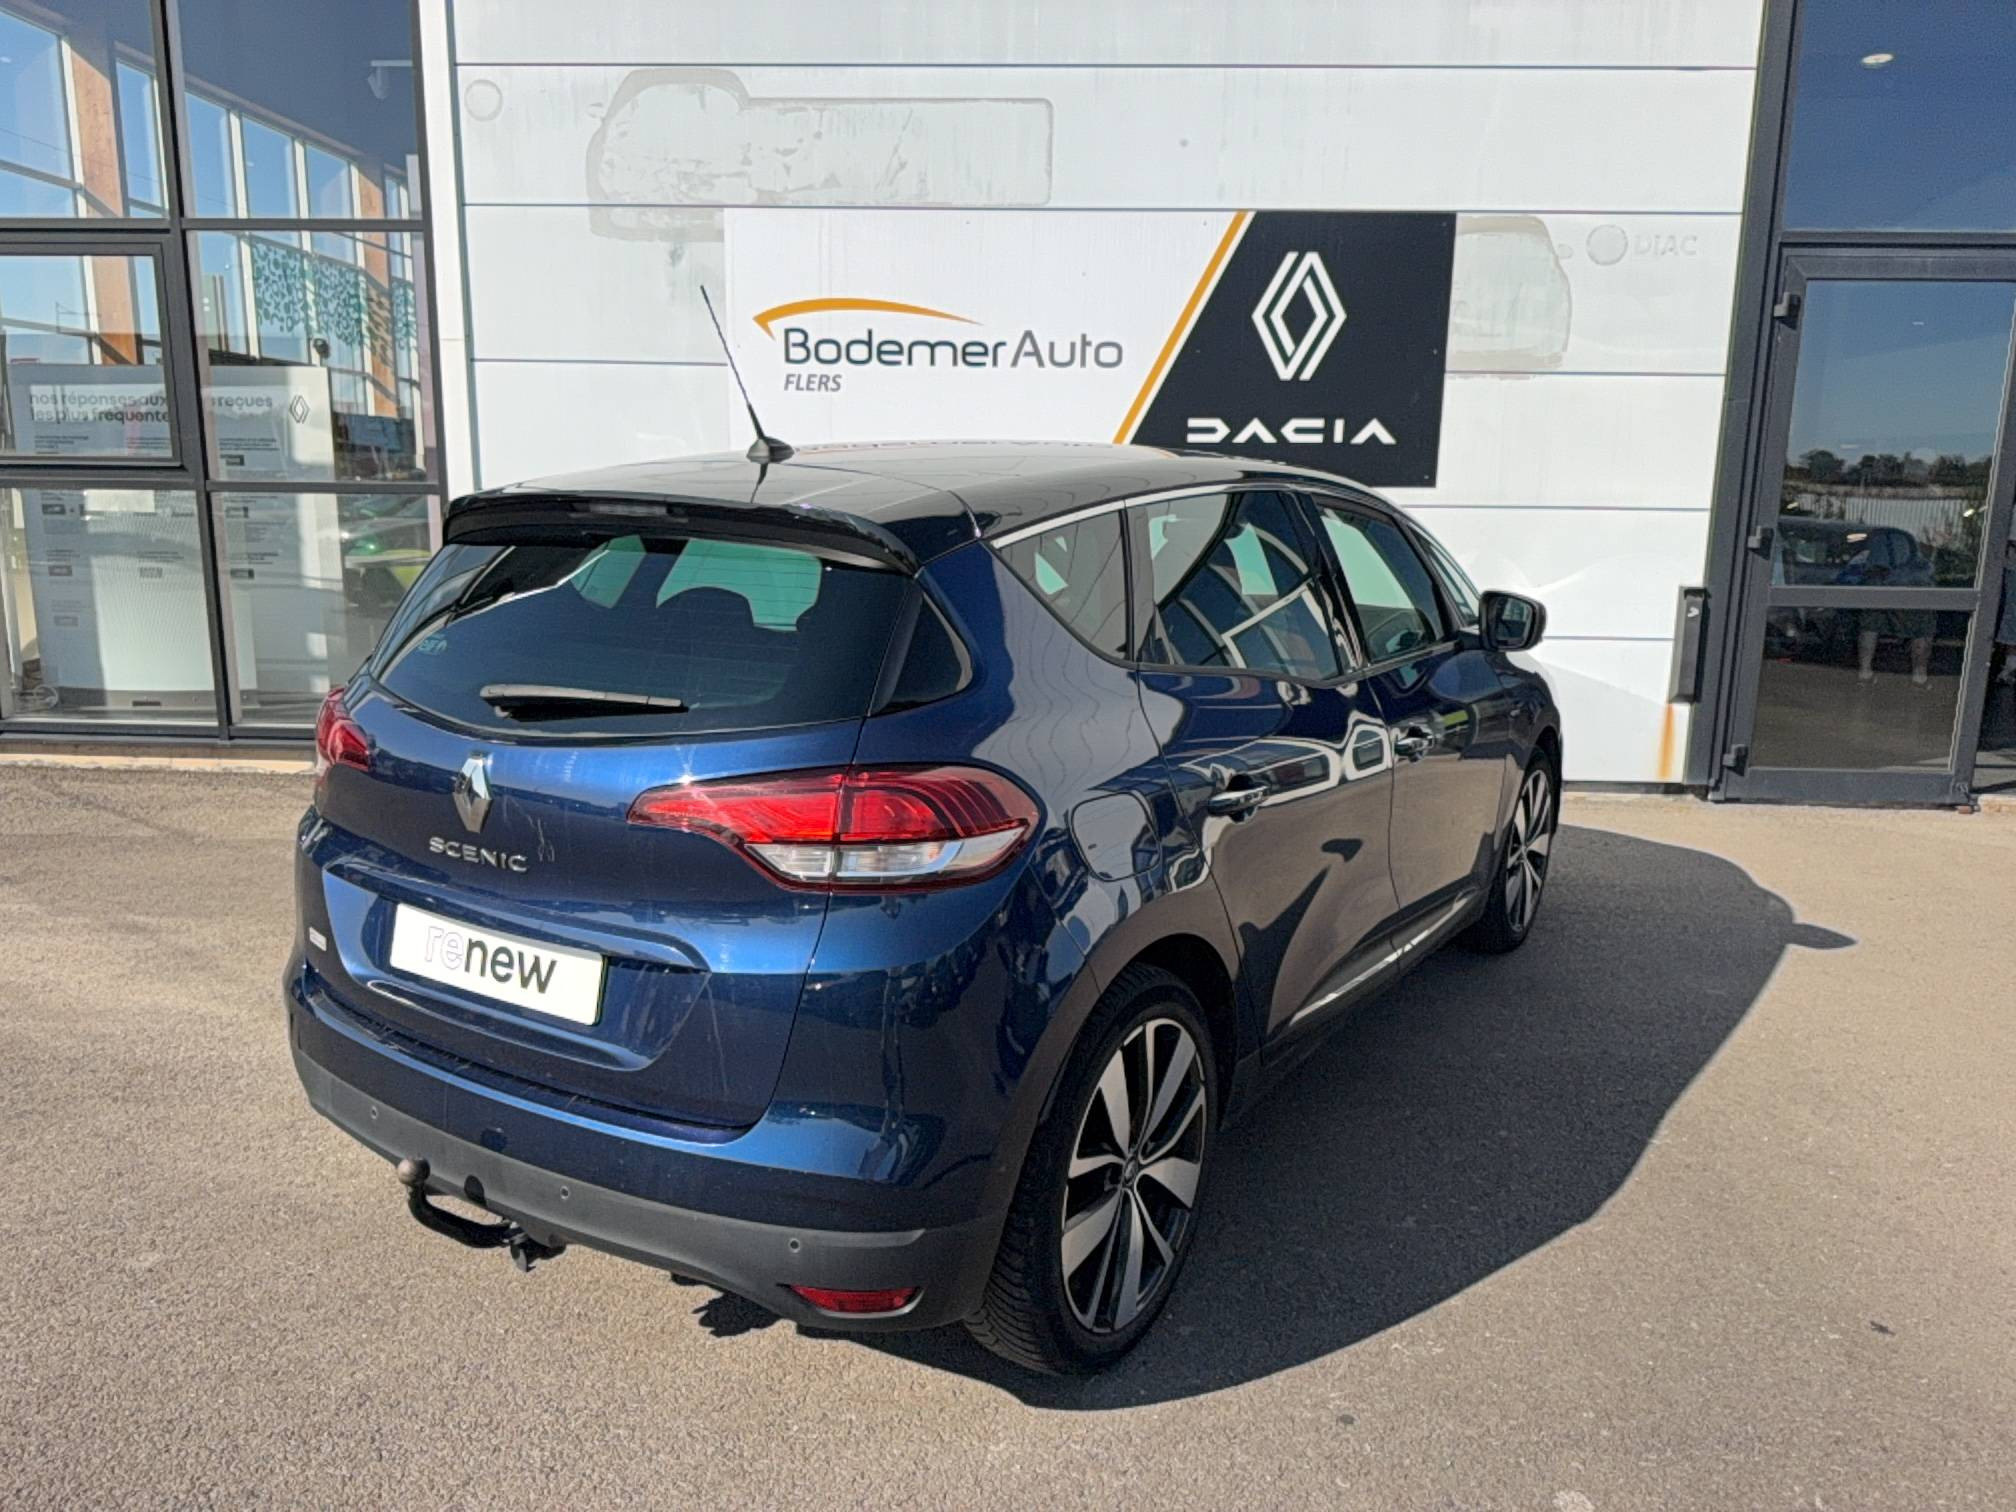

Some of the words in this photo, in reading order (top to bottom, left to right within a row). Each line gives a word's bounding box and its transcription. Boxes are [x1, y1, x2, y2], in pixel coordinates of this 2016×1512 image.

[783, 373, 842, 392] FLERS
[61, 391, 137, 409] réponses
[217, 396, 273, 410] reçues
[92, 406, 168, 425] fréquente
[1186, 417, 1397, 444] DACIA
[429, 836, 528, 872] SCENIC
[424, 925, 558, 995] renew
